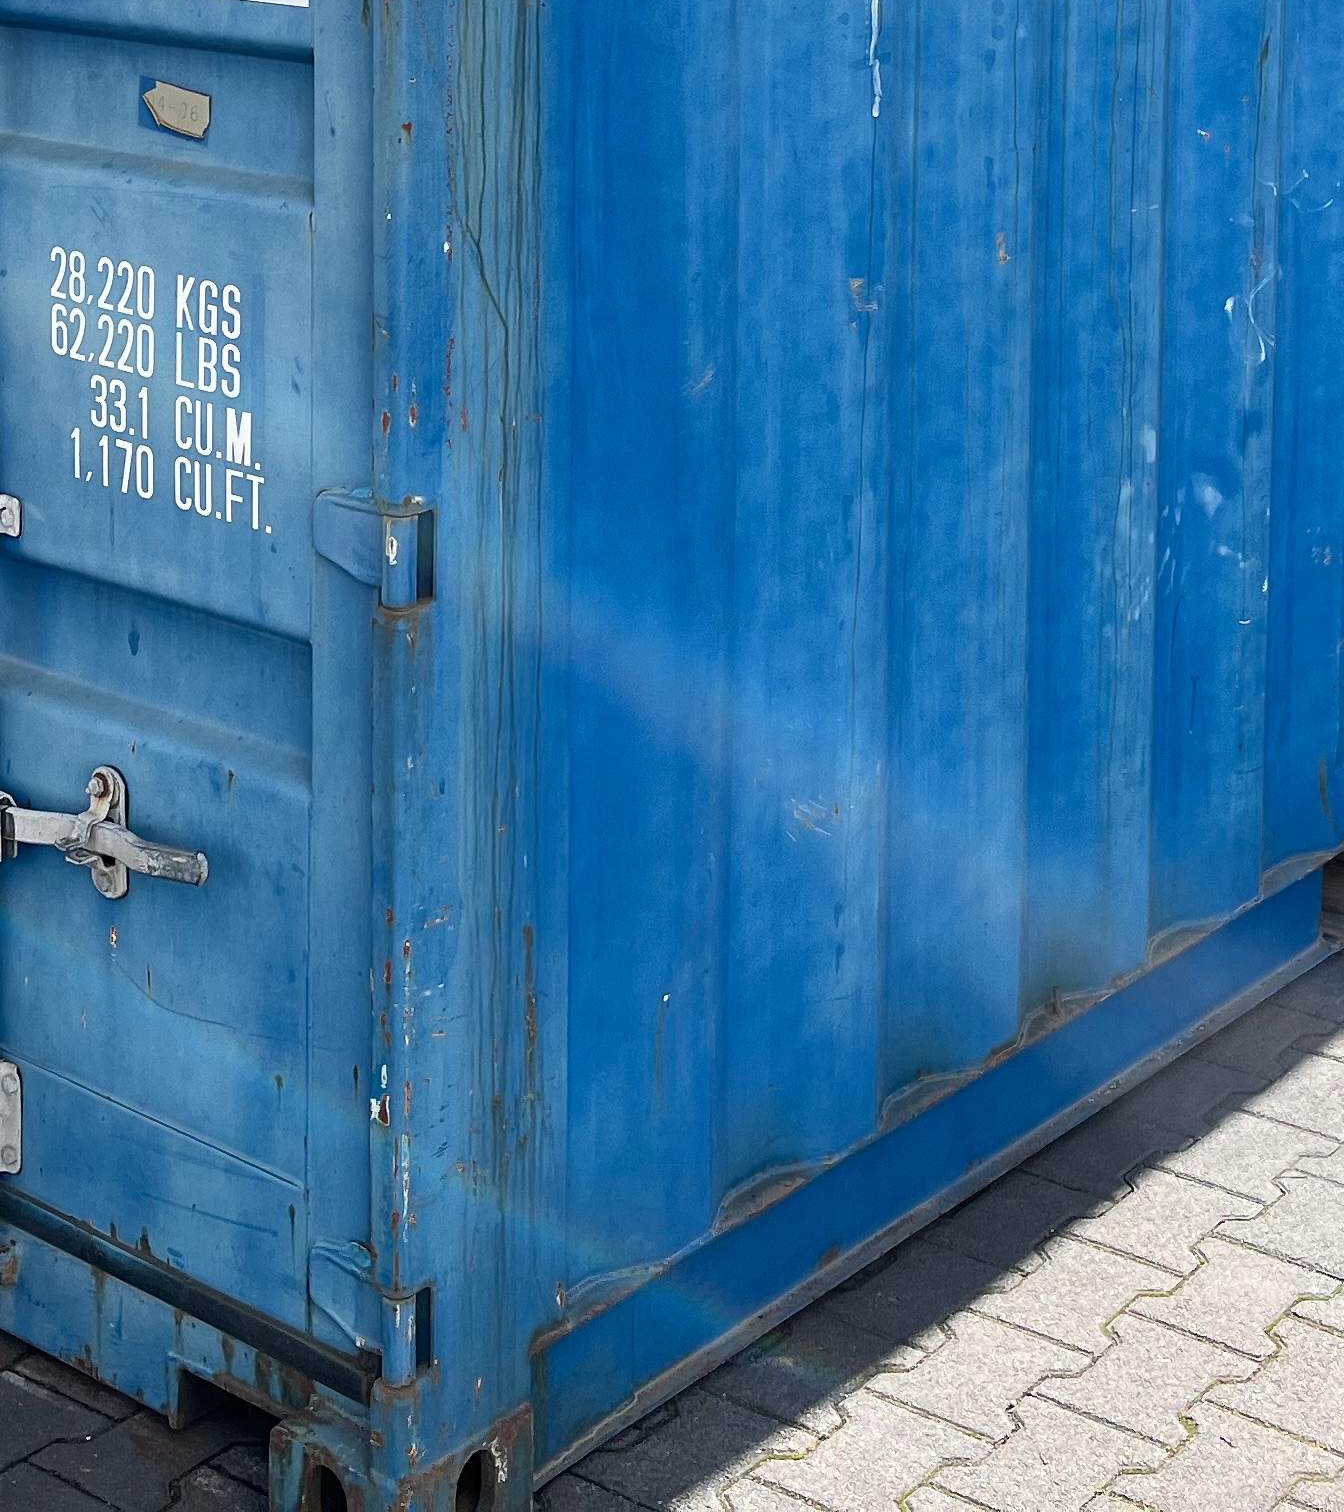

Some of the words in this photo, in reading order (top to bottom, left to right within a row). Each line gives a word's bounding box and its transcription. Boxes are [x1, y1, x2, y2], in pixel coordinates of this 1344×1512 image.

[50, 246, 155, 321] 28,220
[176, 274, 241, 340] KGS
[51, 304, 155, 378] 62,220
[176, 331, 241, 399] LBS
[90, 375, 149, 441] 33.1
[175, 396, 261, 471] CU.M.
[70, 428, 154, 499] 1,170
[174, 456, 272, 534] CU.FT.
